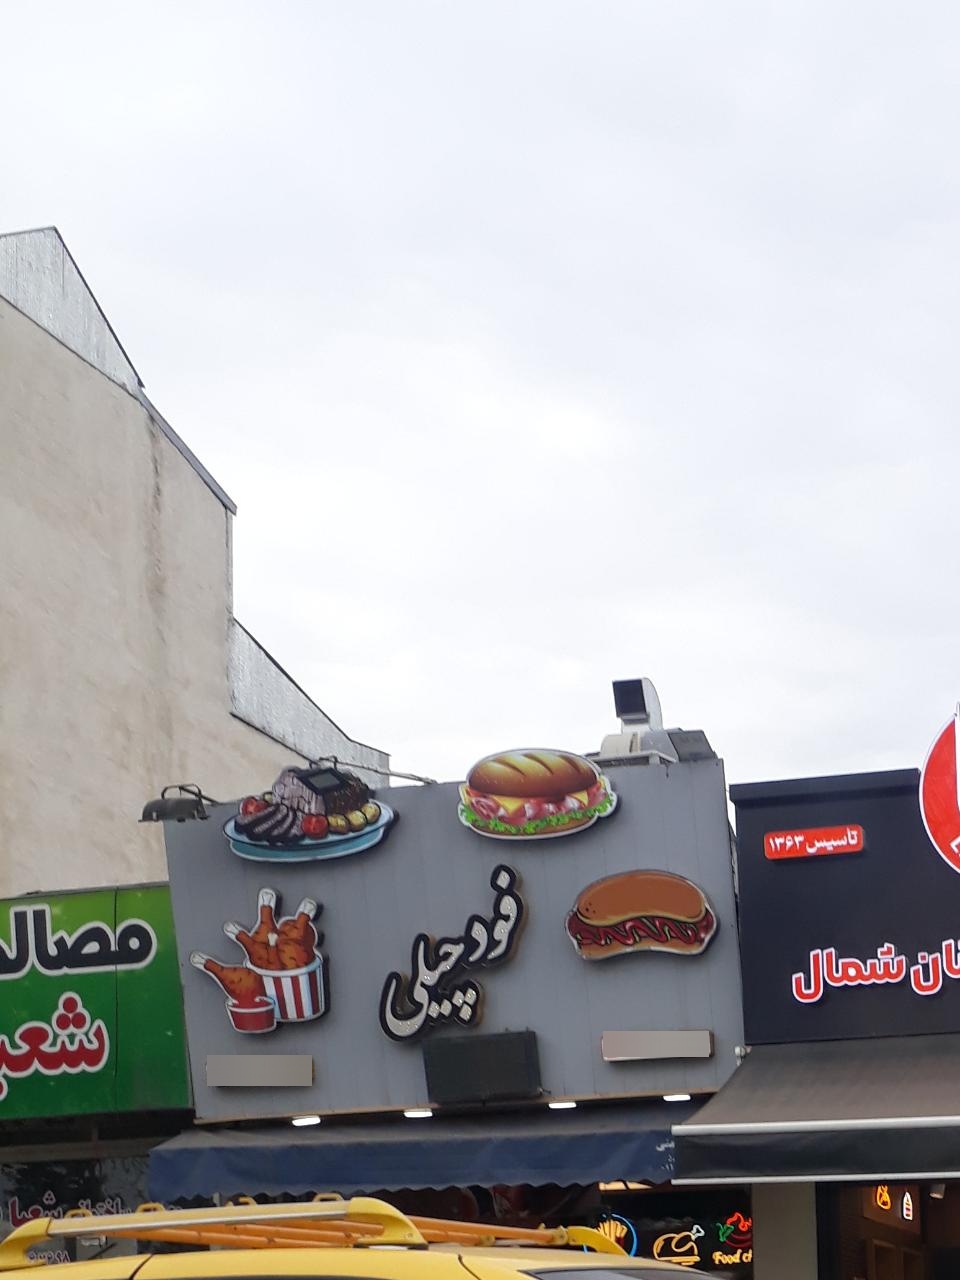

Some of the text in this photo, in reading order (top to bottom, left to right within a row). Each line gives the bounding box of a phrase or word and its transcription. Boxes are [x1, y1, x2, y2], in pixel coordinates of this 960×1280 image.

[768, 834, 805, 853] ۱۳۶۳
[379, 864, 525, 1043] فود چیلی
[792, 941, 906, 1004] شمال
[712, 1248, 743, 1265] Food
